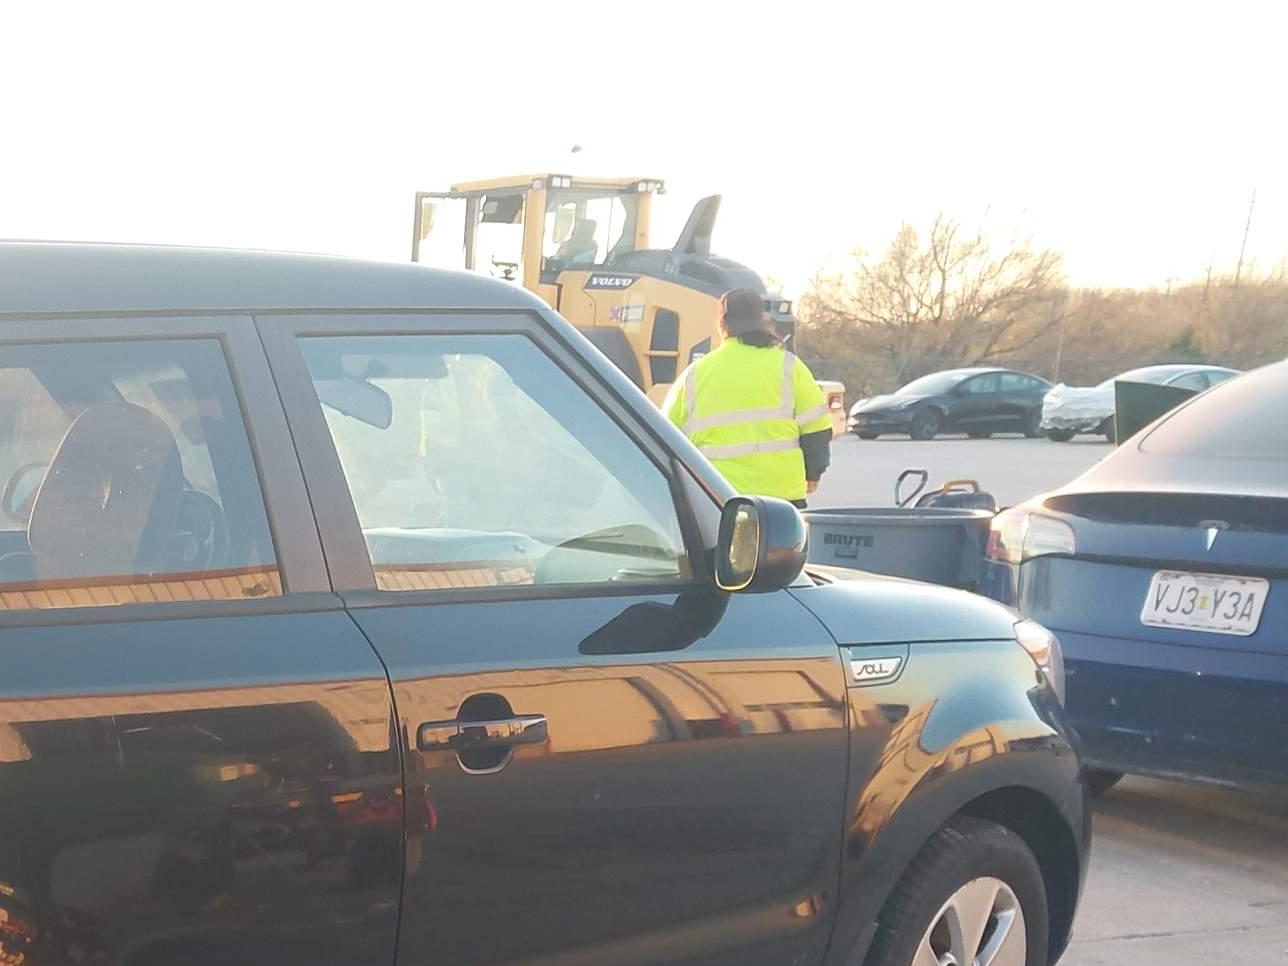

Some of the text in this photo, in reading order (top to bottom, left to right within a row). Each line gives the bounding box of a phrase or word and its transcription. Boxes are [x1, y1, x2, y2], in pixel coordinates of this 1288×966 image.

[591, 276, 633, 287] VOLVO
[823, 533, 874, 547] BRUTE
[1153, 583, 1200, 616] VJ3
[1210, 588, 1256, 622] Y3A
